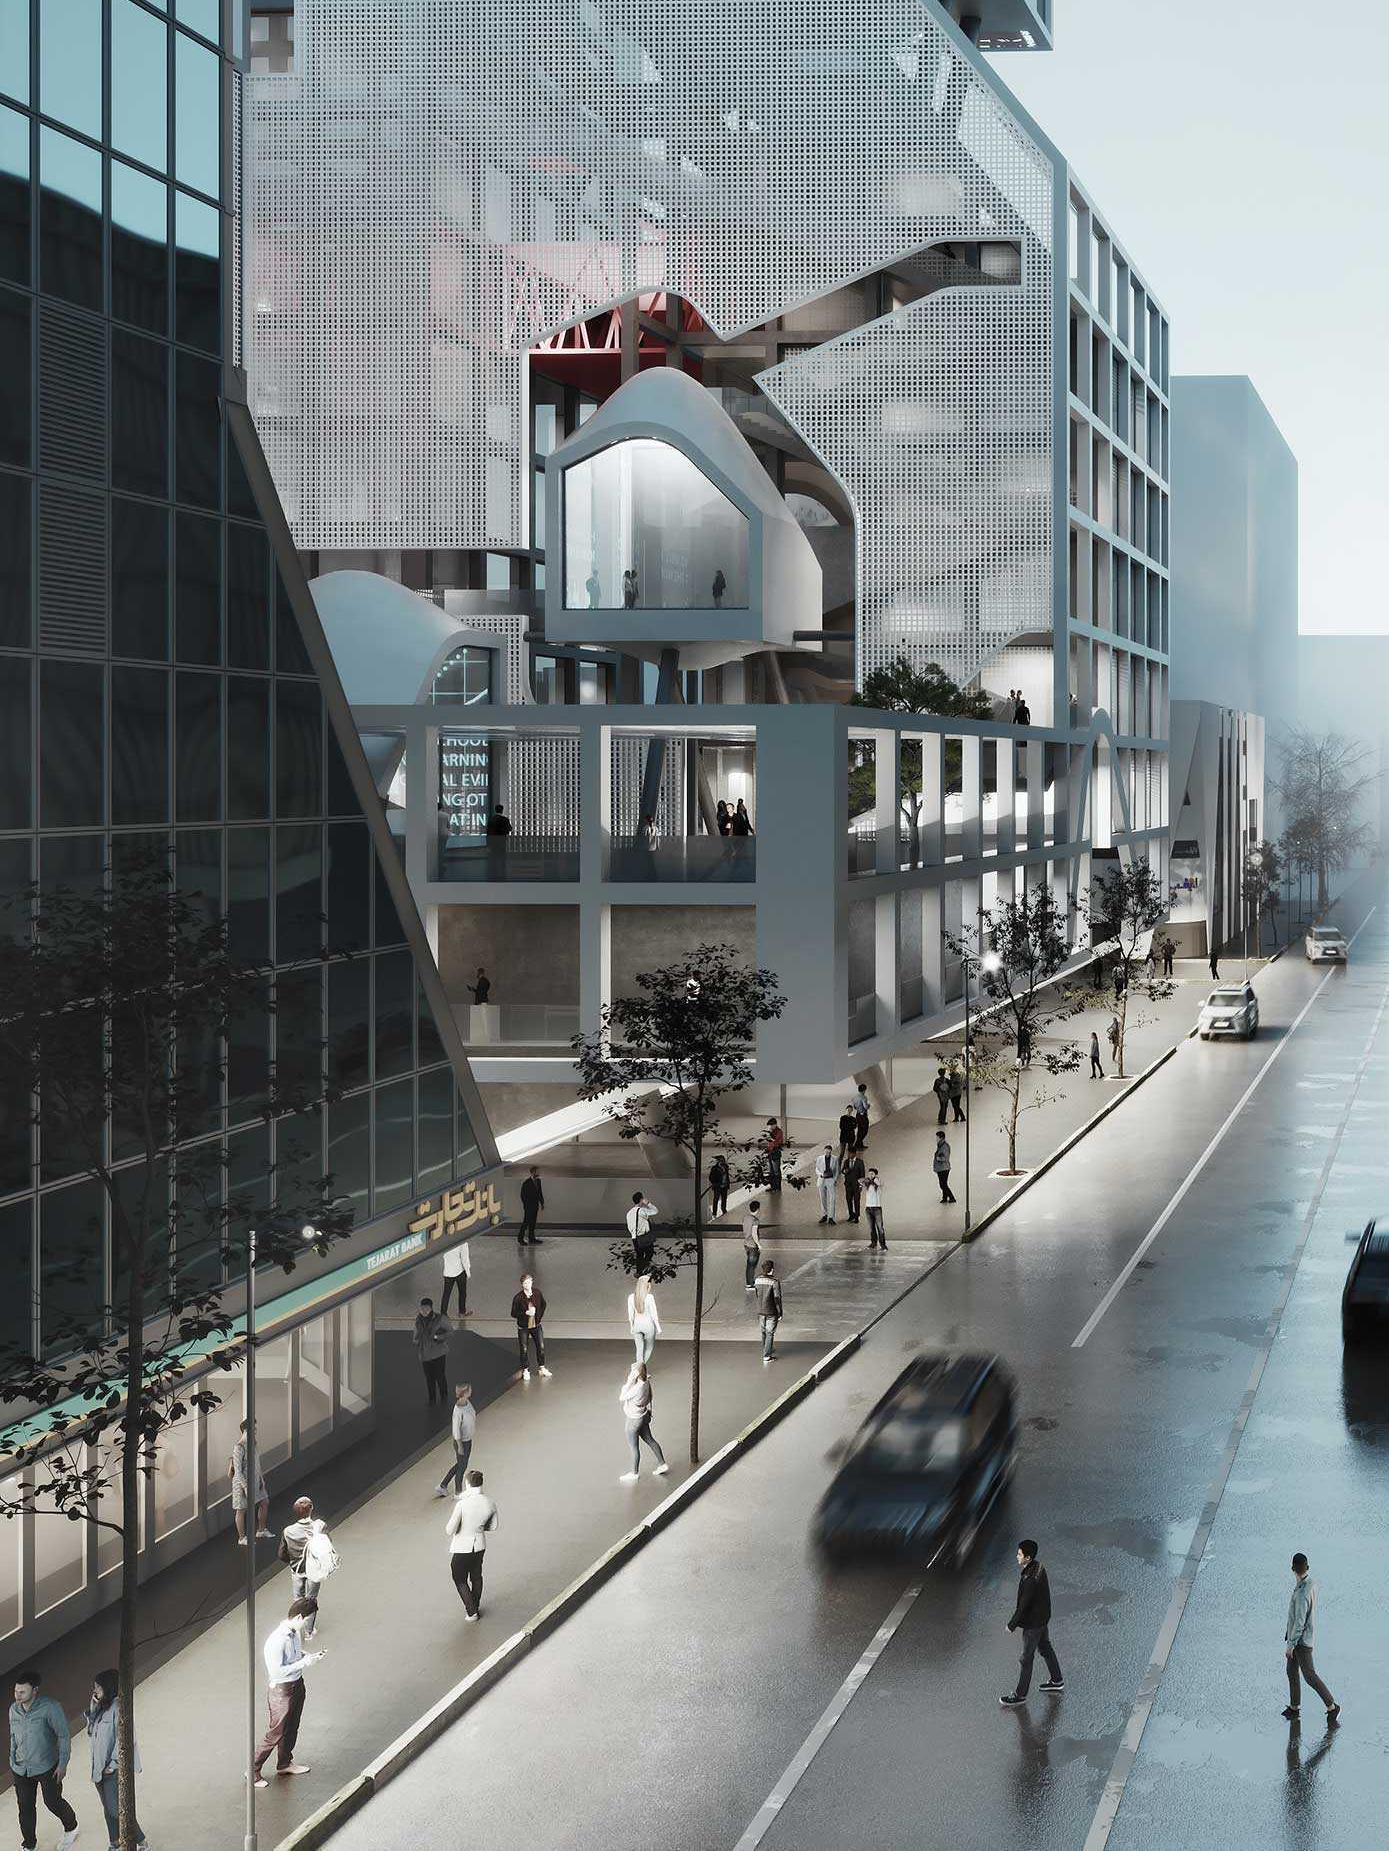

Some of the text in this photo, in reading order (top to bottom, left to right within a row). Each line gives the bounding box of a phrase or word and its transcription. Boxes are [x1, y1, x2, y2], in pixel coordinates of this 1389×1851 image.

[408, 1180, 501, 1240] بانک تجارت
[366, 1233, 423, 1271] TEJARAT BANK
